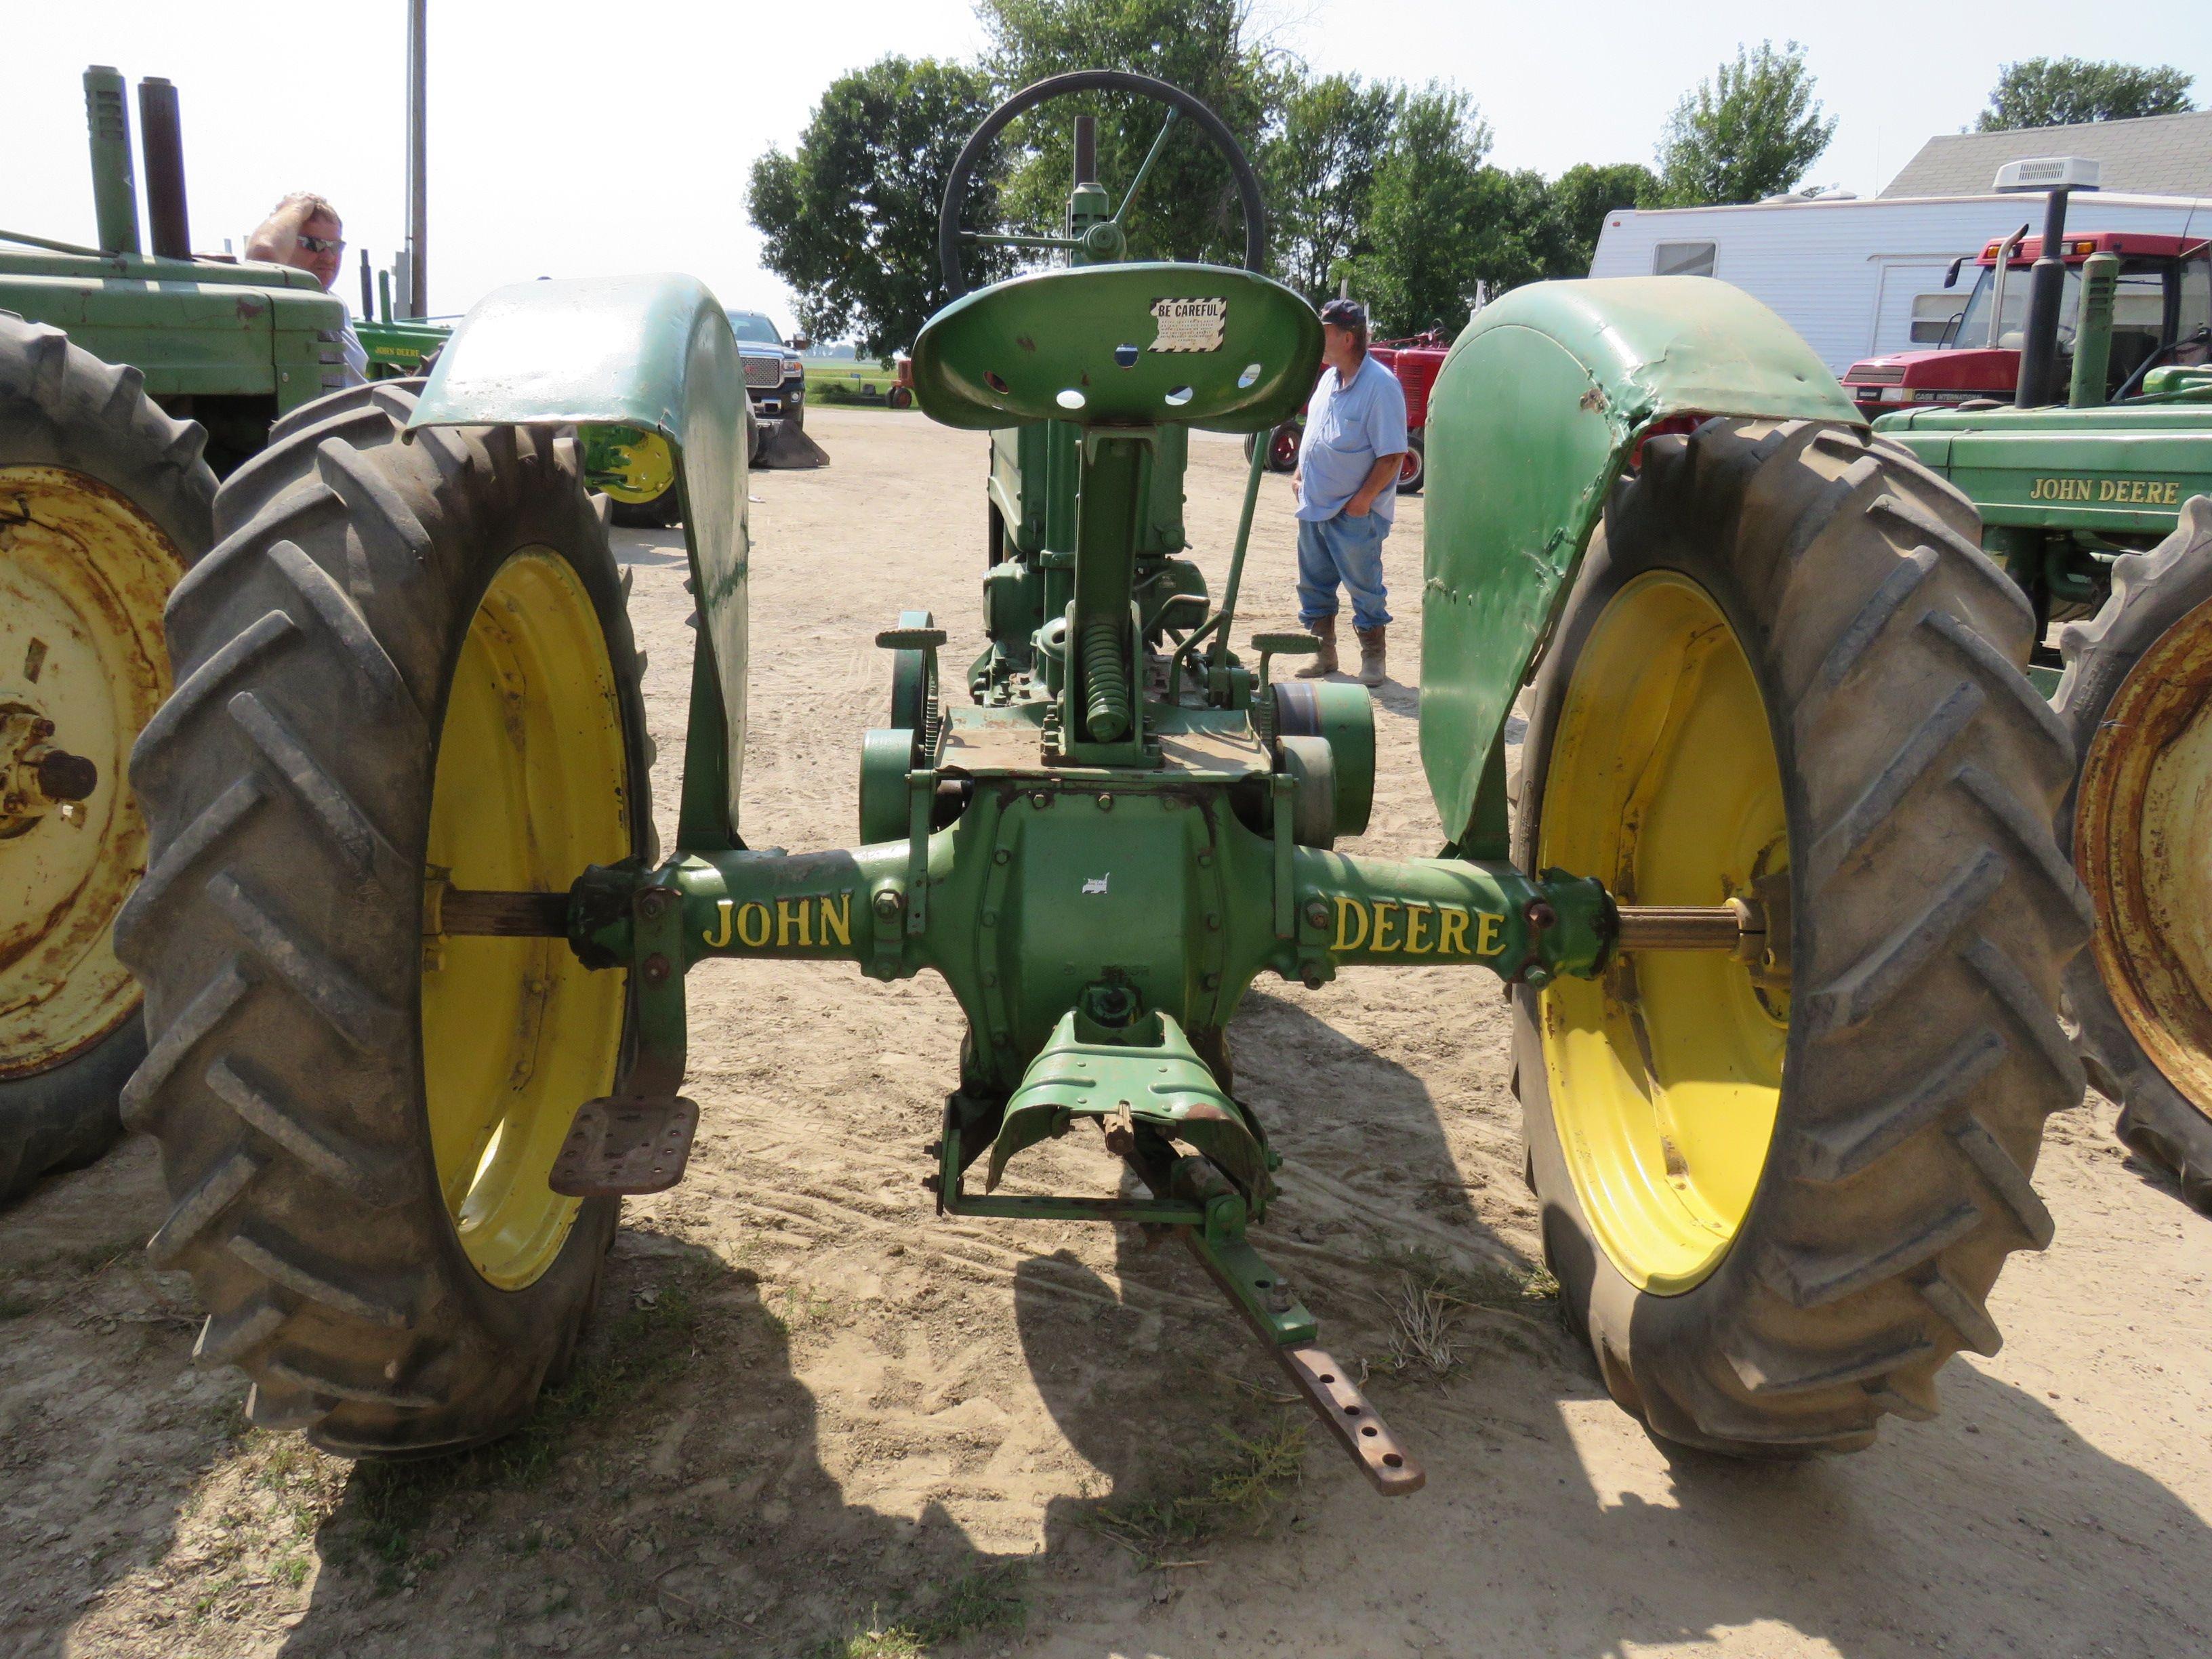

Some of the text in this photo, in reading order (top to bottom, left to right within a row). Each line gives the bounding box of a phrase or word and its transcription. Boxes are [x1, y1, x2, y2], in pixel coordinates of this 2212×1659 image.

[1159, 304, 1218, 316] BE CAREFUL
[375, 346, 419, 357] JOHN DEERE
[1915, 393, 1934, 401] CASE
[2030, 478, 2179, 504] JOHN DEERE
[703, 890, 1506, 956] JOHN DEERE
